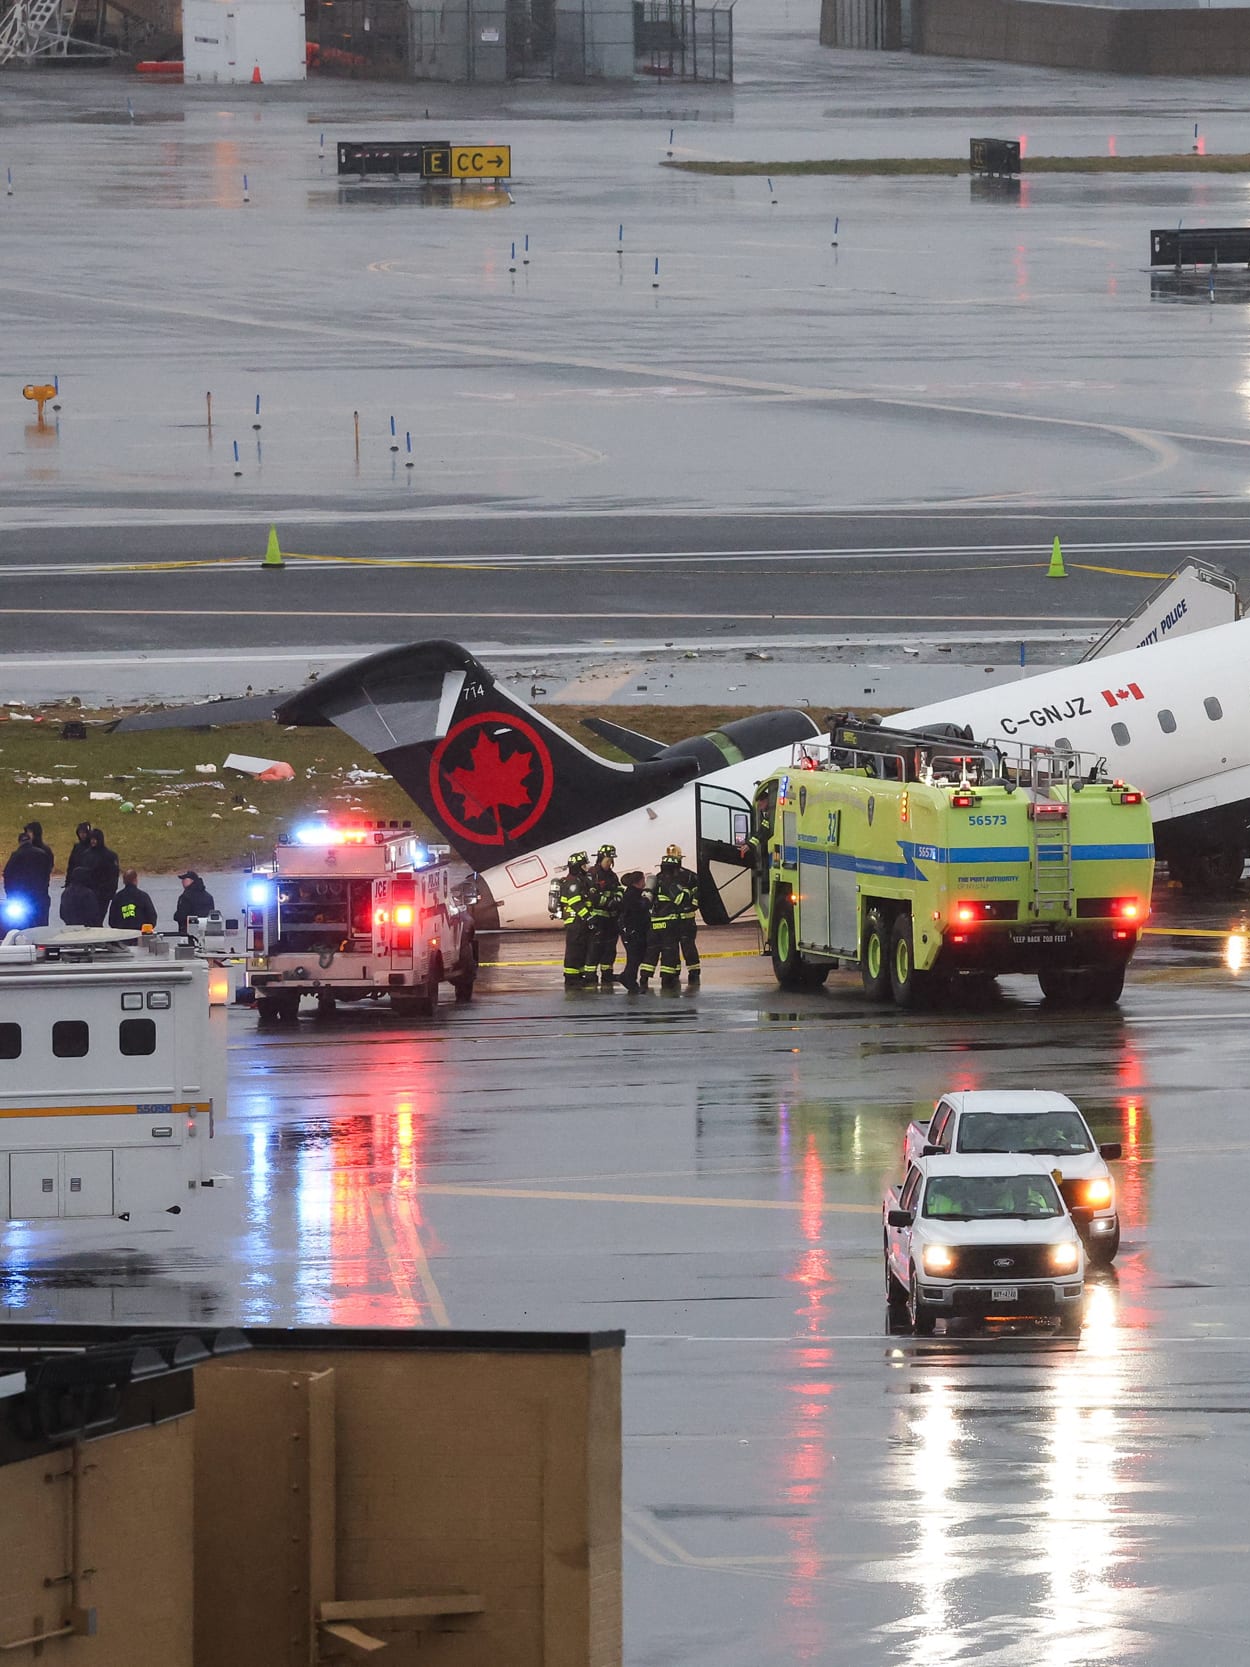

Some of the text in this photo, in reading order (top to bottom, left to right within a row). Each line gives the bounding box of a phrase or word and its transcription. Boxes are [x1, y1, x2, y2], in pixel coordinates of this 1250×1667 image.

[431, 153, 484, 172] E CC
[1160, 598, 1188, 635] POLICE
[463, 684, 484, 700] 714
[1000, 697, 1092, 735] C-GNJZ
[968, 815, 1008, 826] 56573
[1027, 935, 1041, 943] BACK
[1054, 935, 1067, 943] FEET
